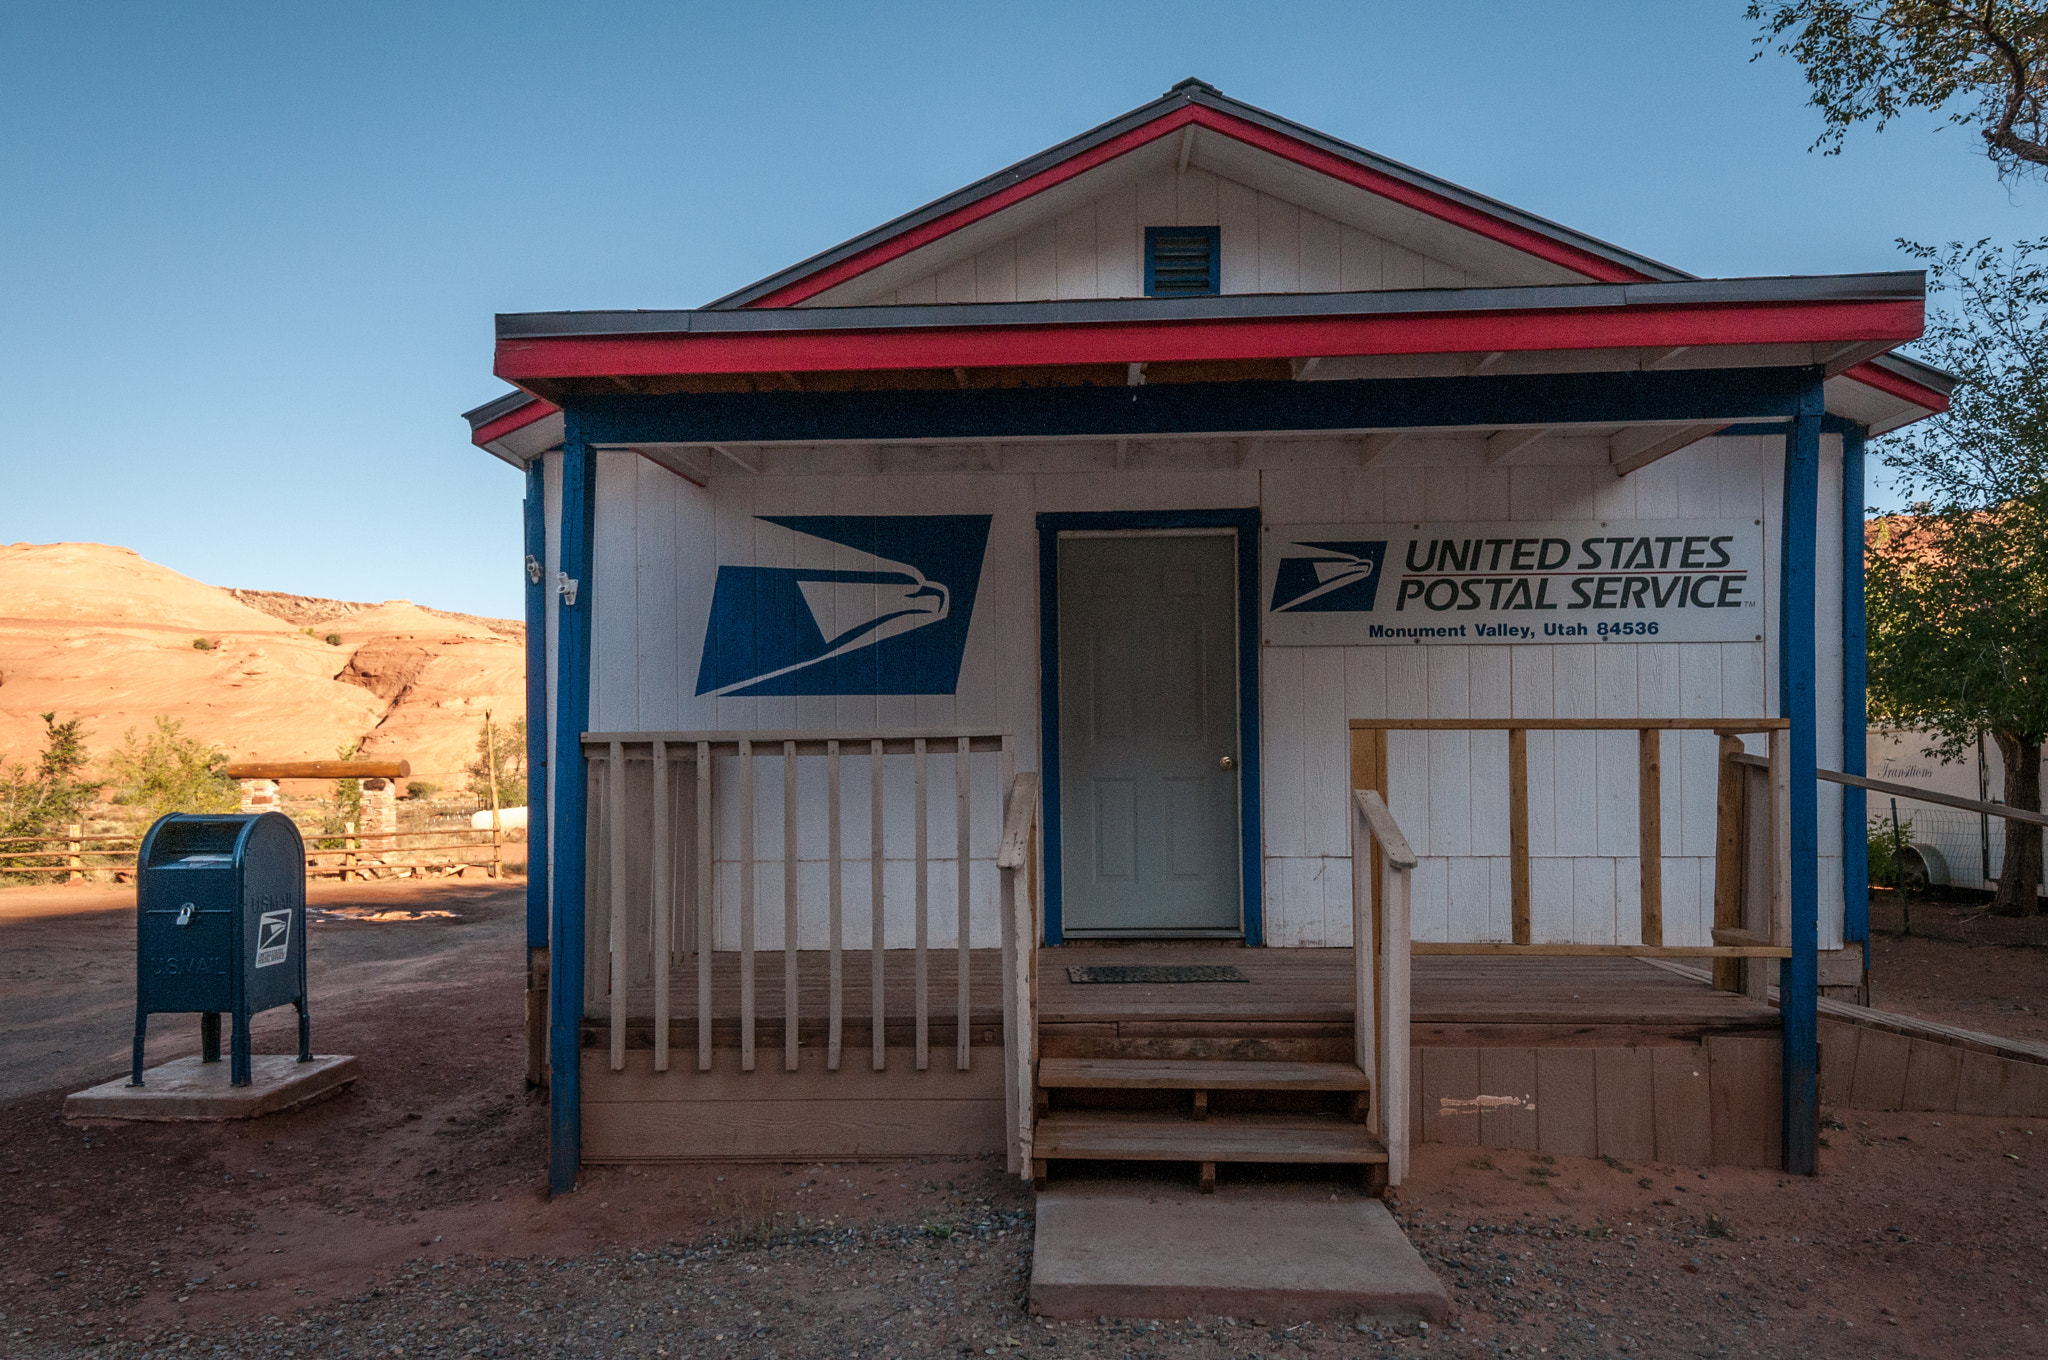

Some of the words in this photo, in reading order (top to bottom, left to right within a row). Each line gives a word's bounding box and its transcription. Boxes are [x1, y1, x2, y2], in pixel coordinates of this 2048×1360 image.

[1405, 538, 1571, 572] UNITED
[1577, 535, 1734, 570] STATES
[1395, 577, 1558, 612] POSTAL
[1567, 575, 1747, 609] SERVICE
[1368, 624, 1467, 639] Monument
[1474, 623, 1535, 639] Valley,
[1543, 622, 1588, 637] Utah
[1596, 621, 1659, 636] 84536
